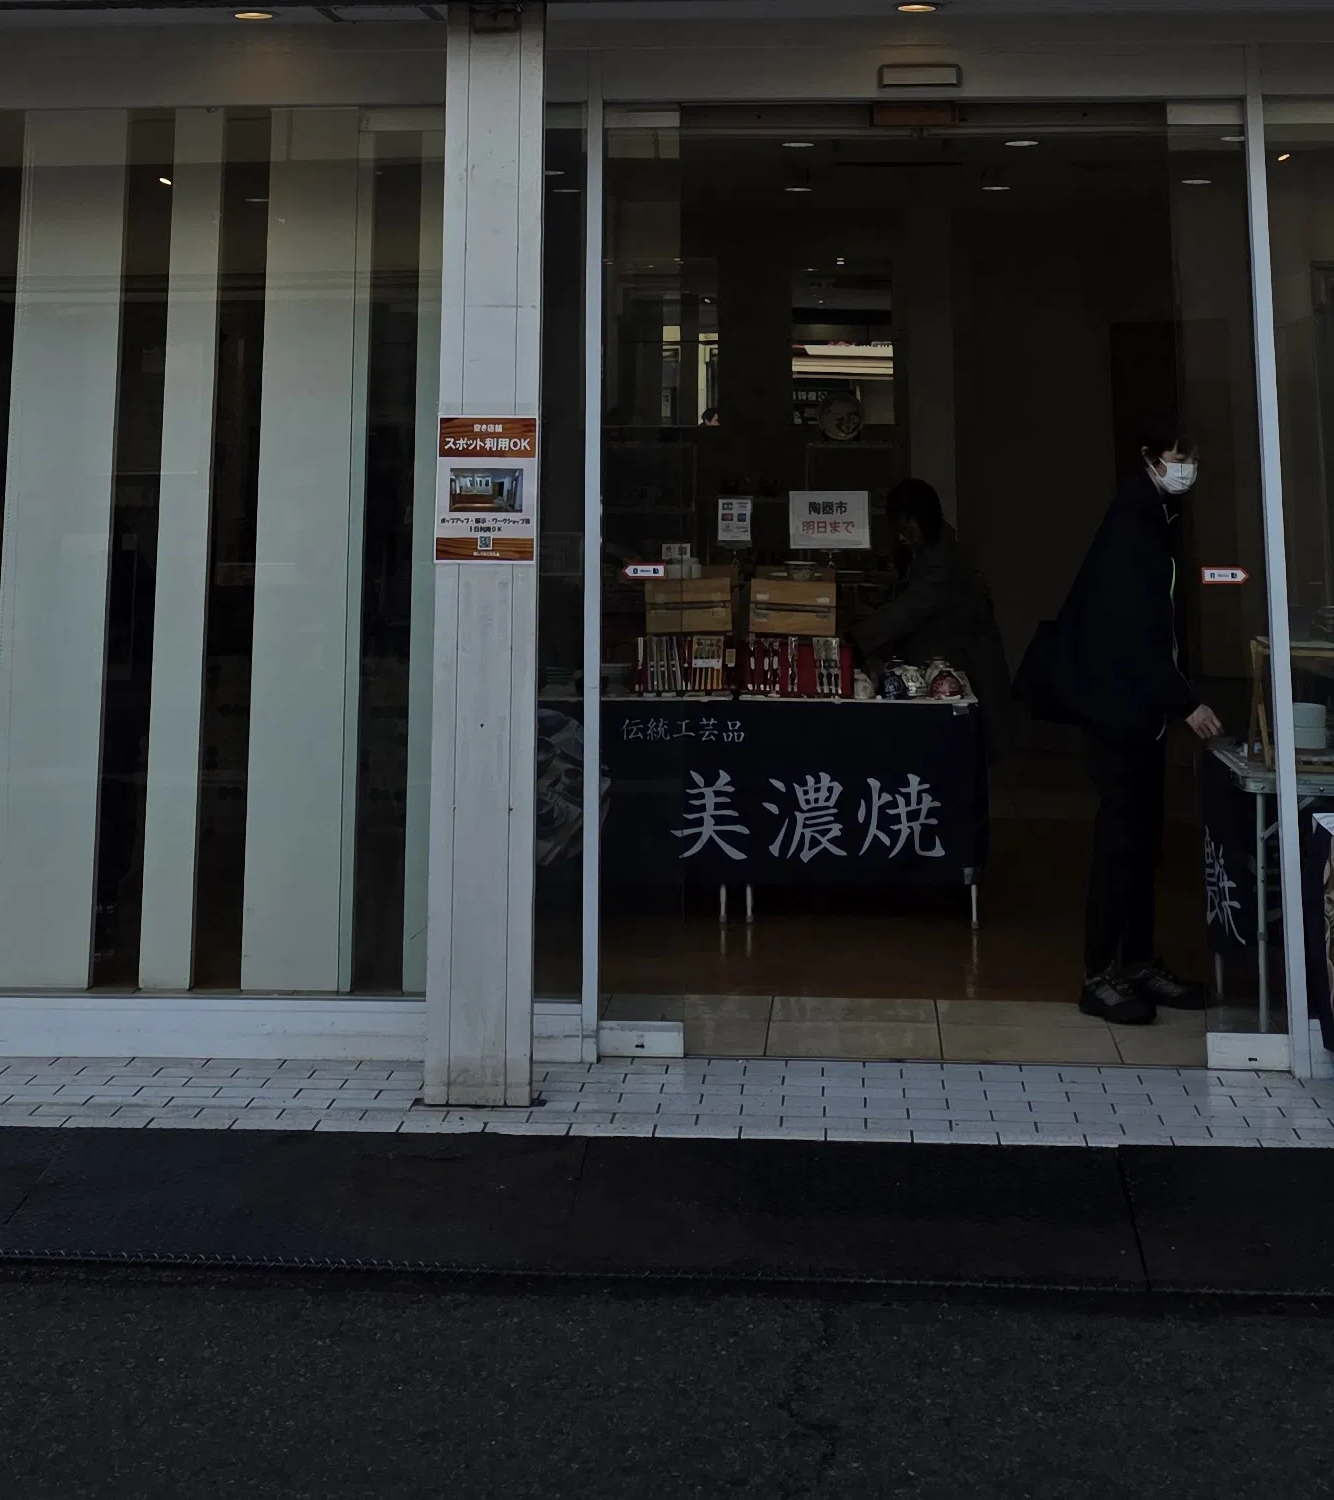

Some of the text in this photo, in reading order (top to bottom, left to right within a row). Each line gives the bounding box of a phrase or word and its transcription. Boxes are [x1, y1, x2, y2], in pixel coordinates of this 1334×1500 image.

[473, 423, 503, 433] 空き店舗
[444, 437, 531, 451] スポット利用OK
[808, 500, 848, 516] 陶器市
[801, 520, 855, 535] 明日まで
[619, 716, 746, 743] 伝統工芸品
[670, 768, 946, 864] 美濃焼
